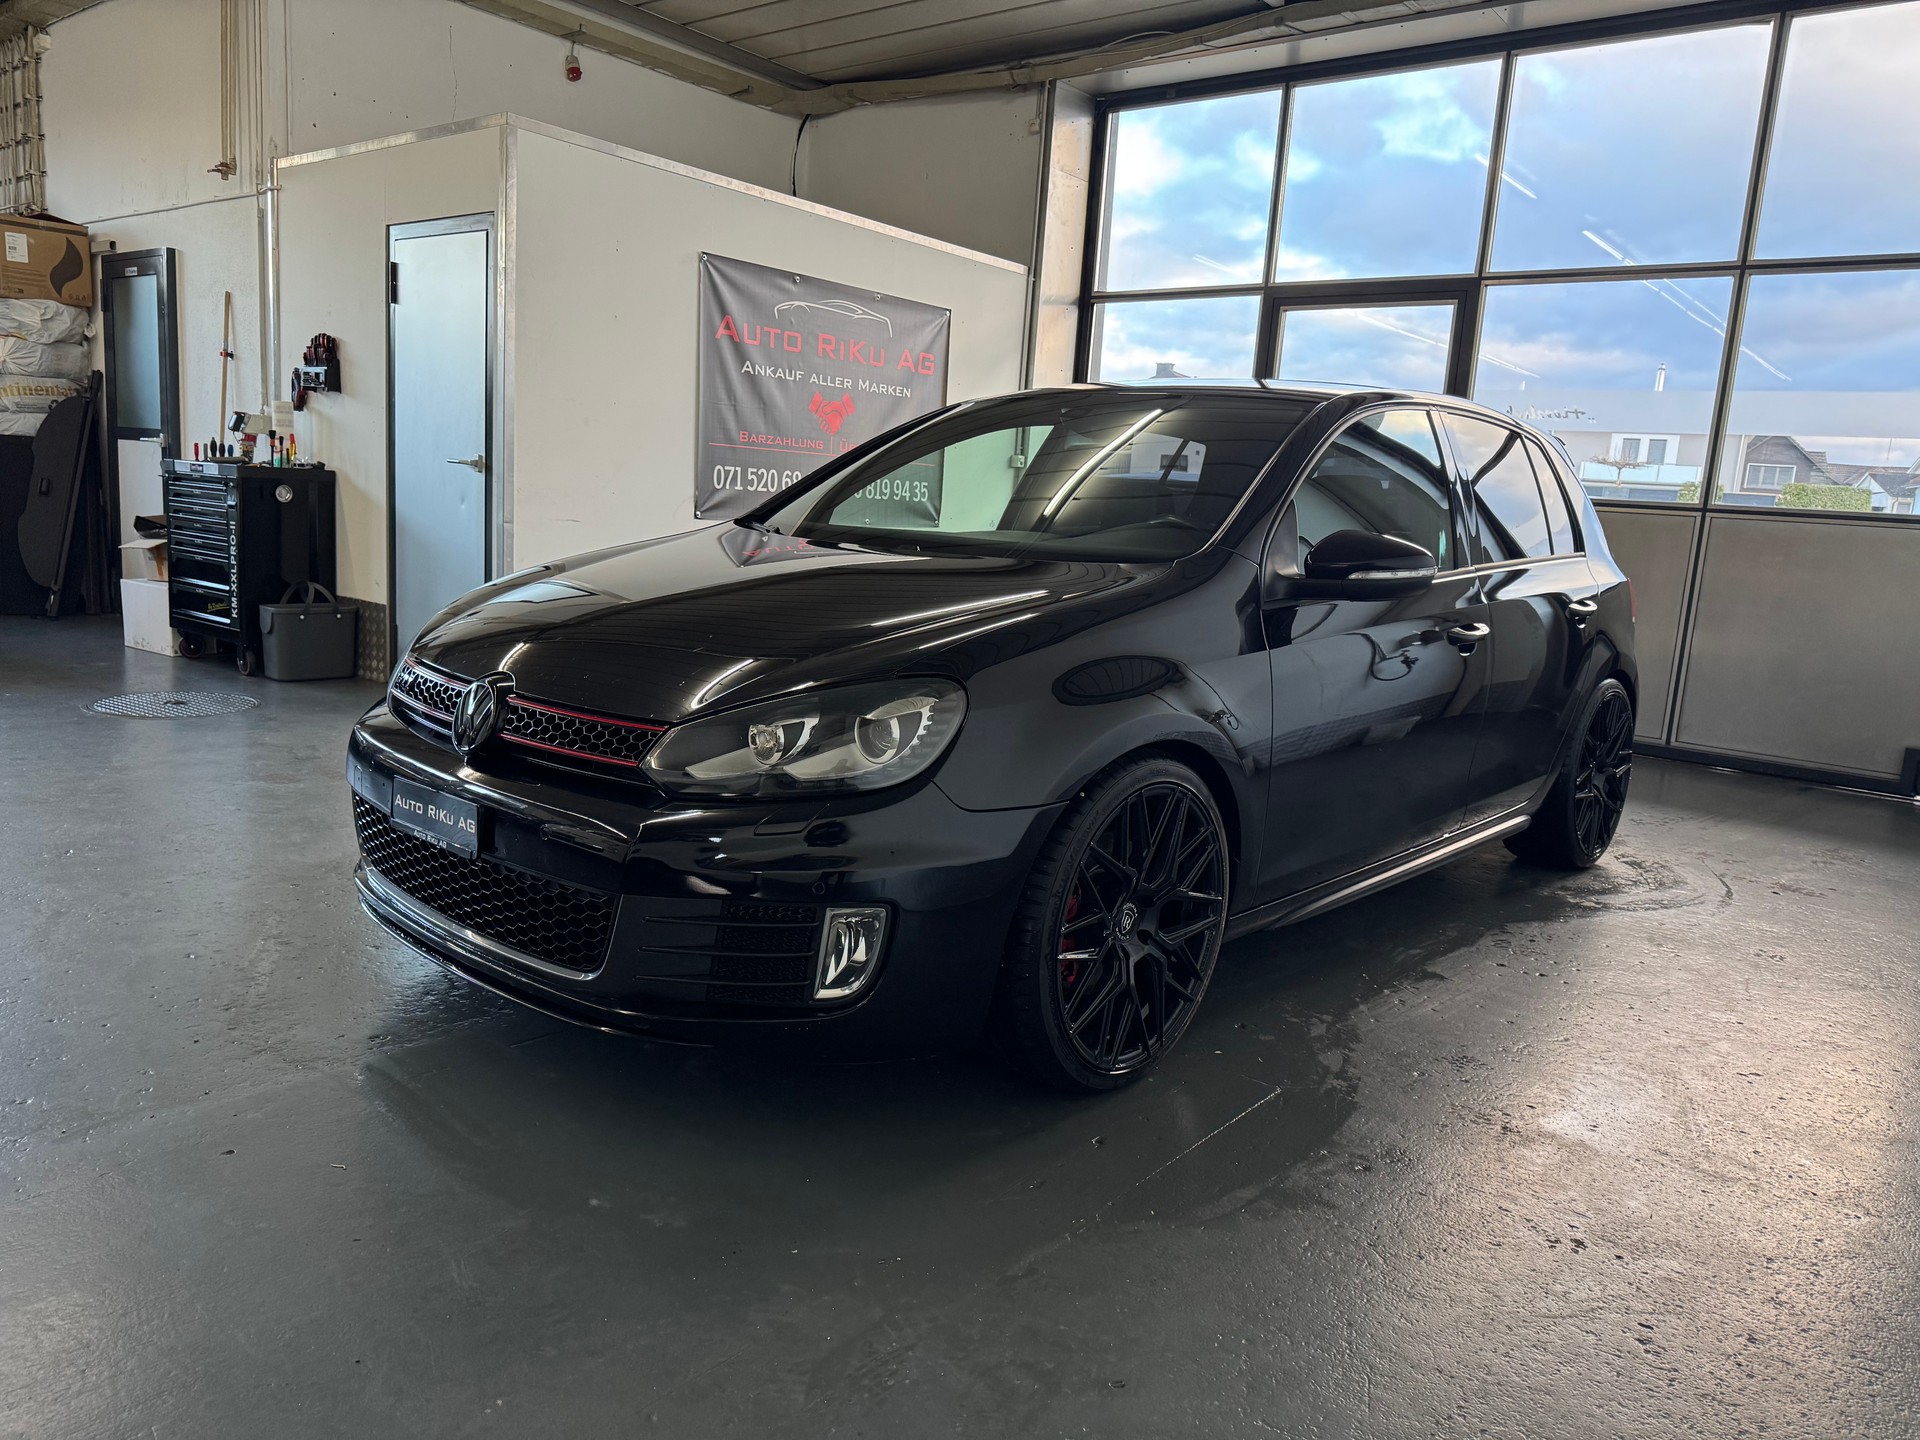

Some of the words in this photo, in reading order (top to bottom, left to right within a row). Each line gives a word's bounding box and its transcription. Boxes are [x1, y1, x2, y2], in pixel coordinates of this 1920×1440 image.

[715, 314, 802, 353] AUTO
[897, 349, 936, 376] AG
[741, 360, 805, 382] ANKAUF
[809, 372, 853, 390] ALLER
[858, 378, 912, 398] MARKEN
[739, 431, 824, 449] BARZAHLUNG
[713, 464, 744, 490] 071
[748, 468, 778, 493] 520
[866, 478, 891, 500] 819
[893, 479, 911, 502] 94
[912, 481, 929, 502] 35
[394, 794, 423, 815] AUTO
[427, 804, 454, 826] RIKU
[458, 816, 476, 834] AG
